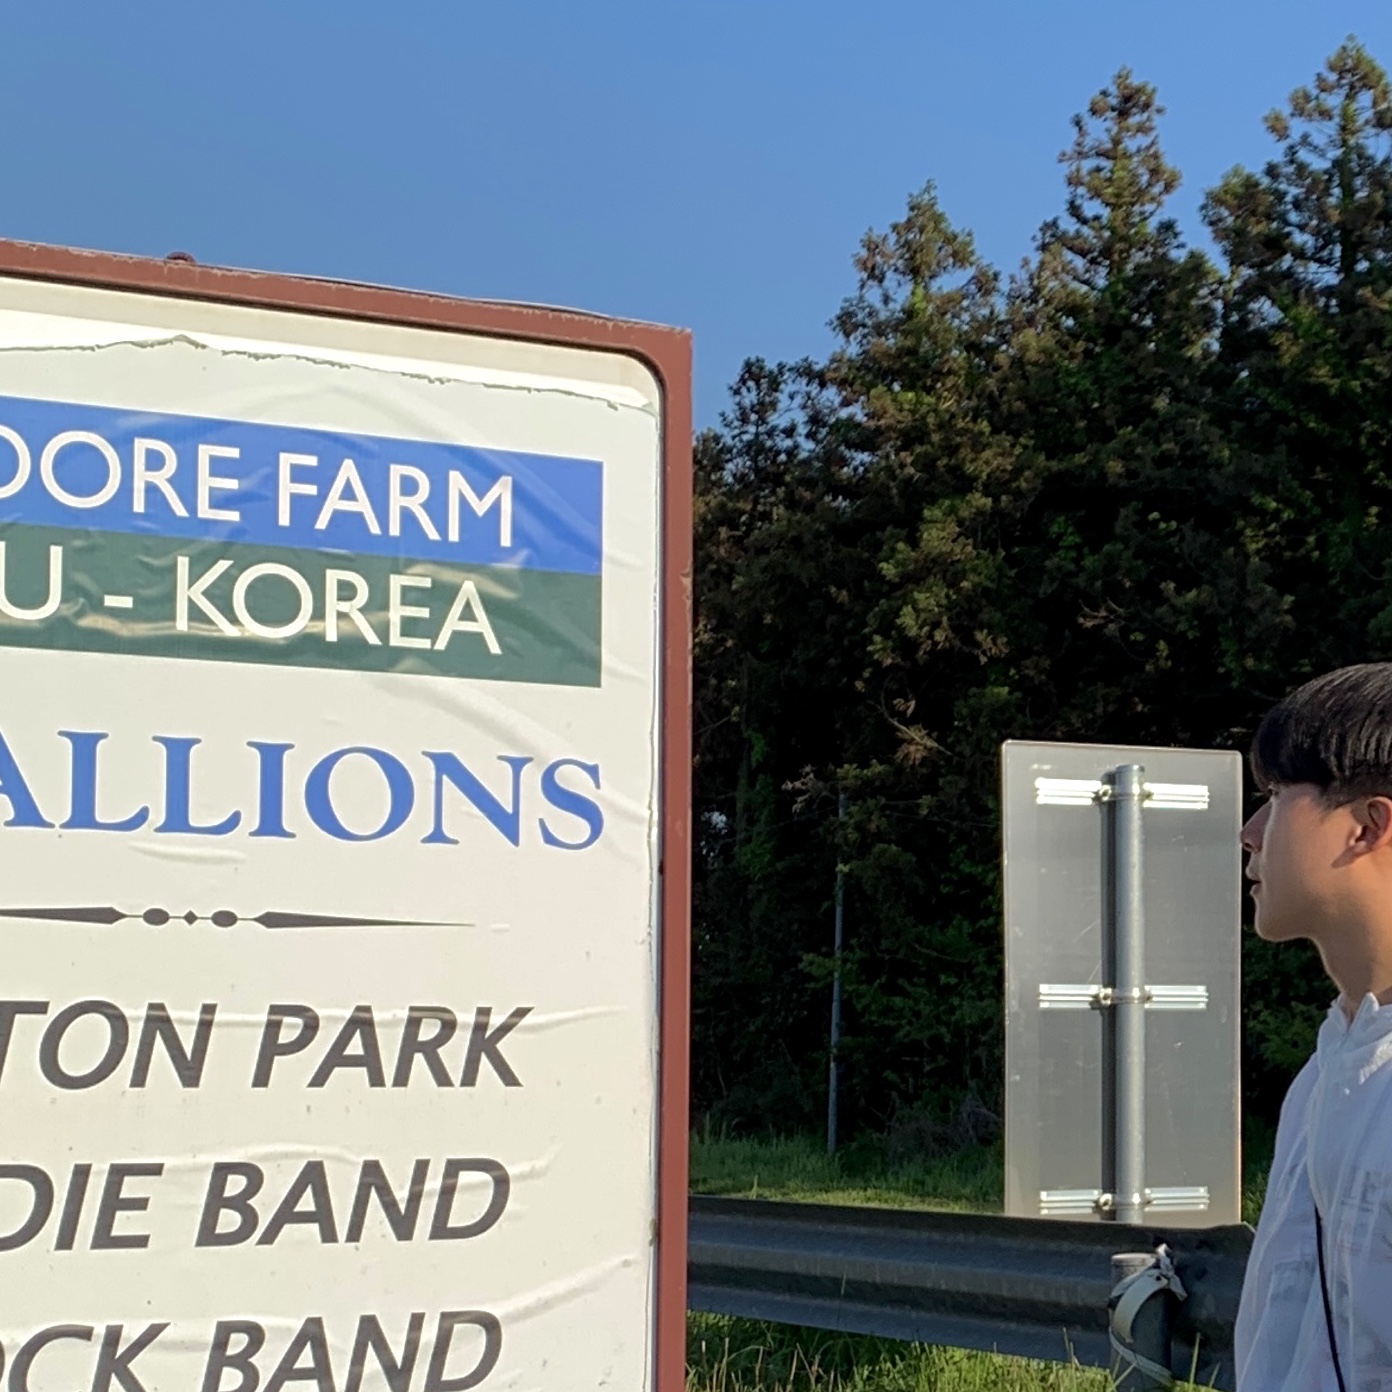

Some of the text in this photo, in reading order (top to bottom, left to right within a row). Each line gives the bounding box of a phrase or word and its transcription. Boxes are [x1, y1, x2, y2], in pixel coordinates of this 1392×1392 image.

[278, 451, 513, 548] FARM
[0, 541, 63, 620] U
[176, 555, 502, 655] KOREA
[0, 999, 535, 1091] TON PARK
[0, 1156, 512, 1252] DIE BAND
